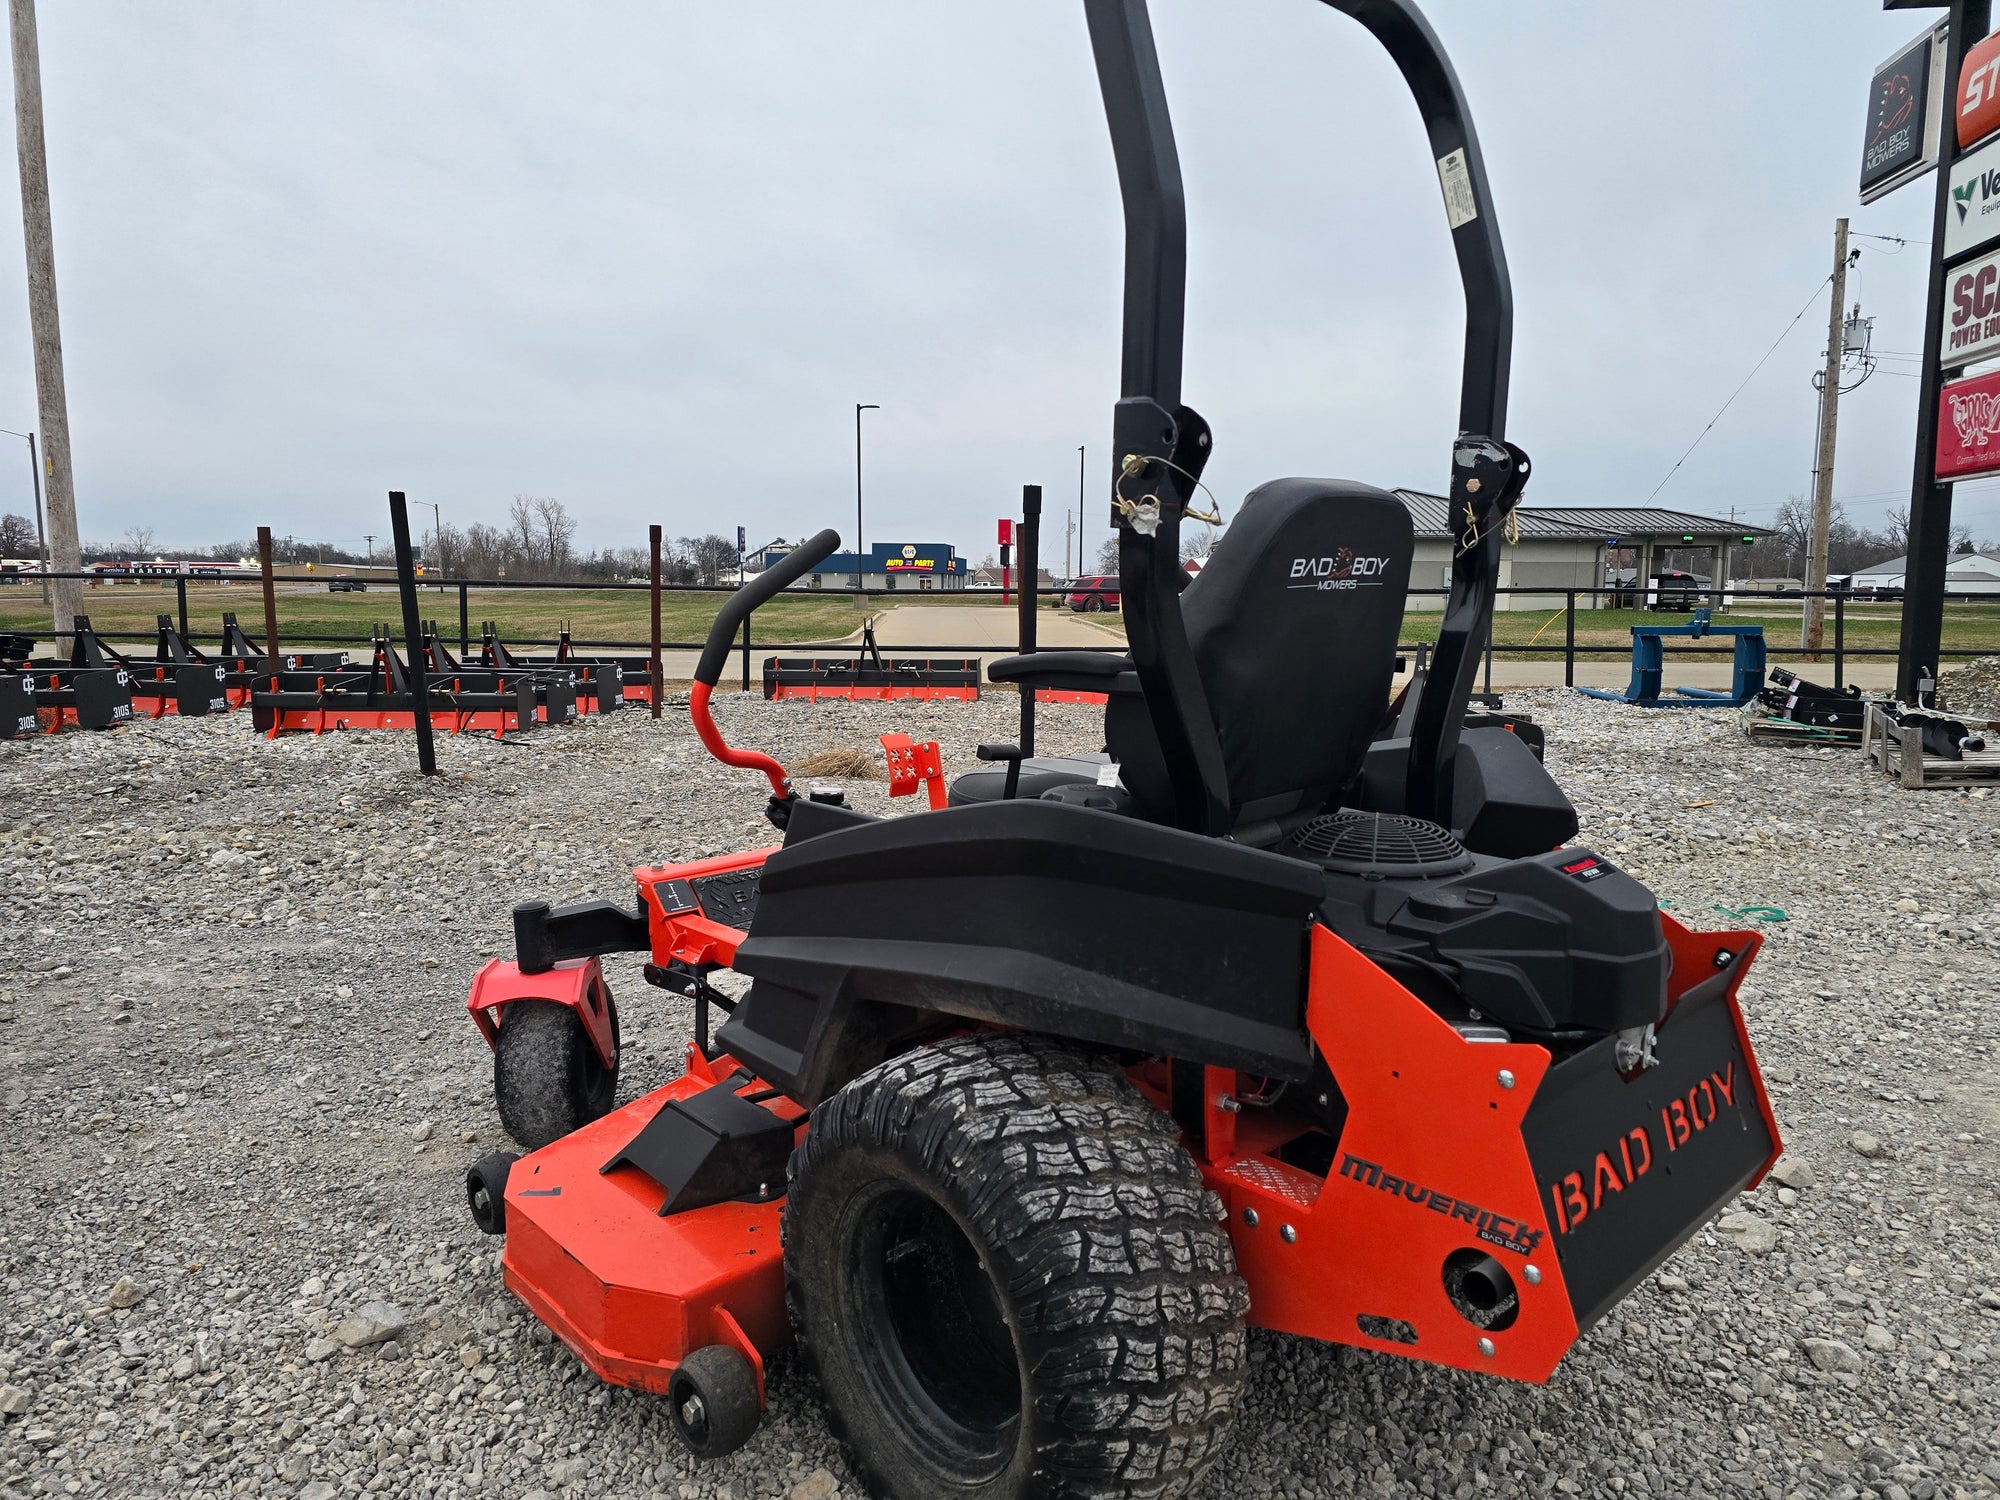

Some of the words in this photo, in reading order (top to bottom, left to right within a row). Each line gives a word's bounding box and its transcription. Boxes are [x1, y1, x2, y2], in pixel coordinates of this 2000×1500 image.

[1866, 137, 1910, 171] MOWERS
[1867, 140, 1887, 160] BAD
[1889, 124, 1910, 147] BOY
[1949, 322, 1981, 351] POWER
[885, 559, 904, 567] AUTO
[914, 559, 935, 567] PARTS
[1290, 558, 1324, 578] BAD
[1351, 558, 1390, 575] BOY
[1317, 579, 1357, 590] MOWERS
[1552, 1127, 1651, 1235] BAD
[1661, 1061, 1734, 1152] BOY
[1481, 1231, 1503, 1245] BAD
[1505, 1240, 1528, 1254] BOY
